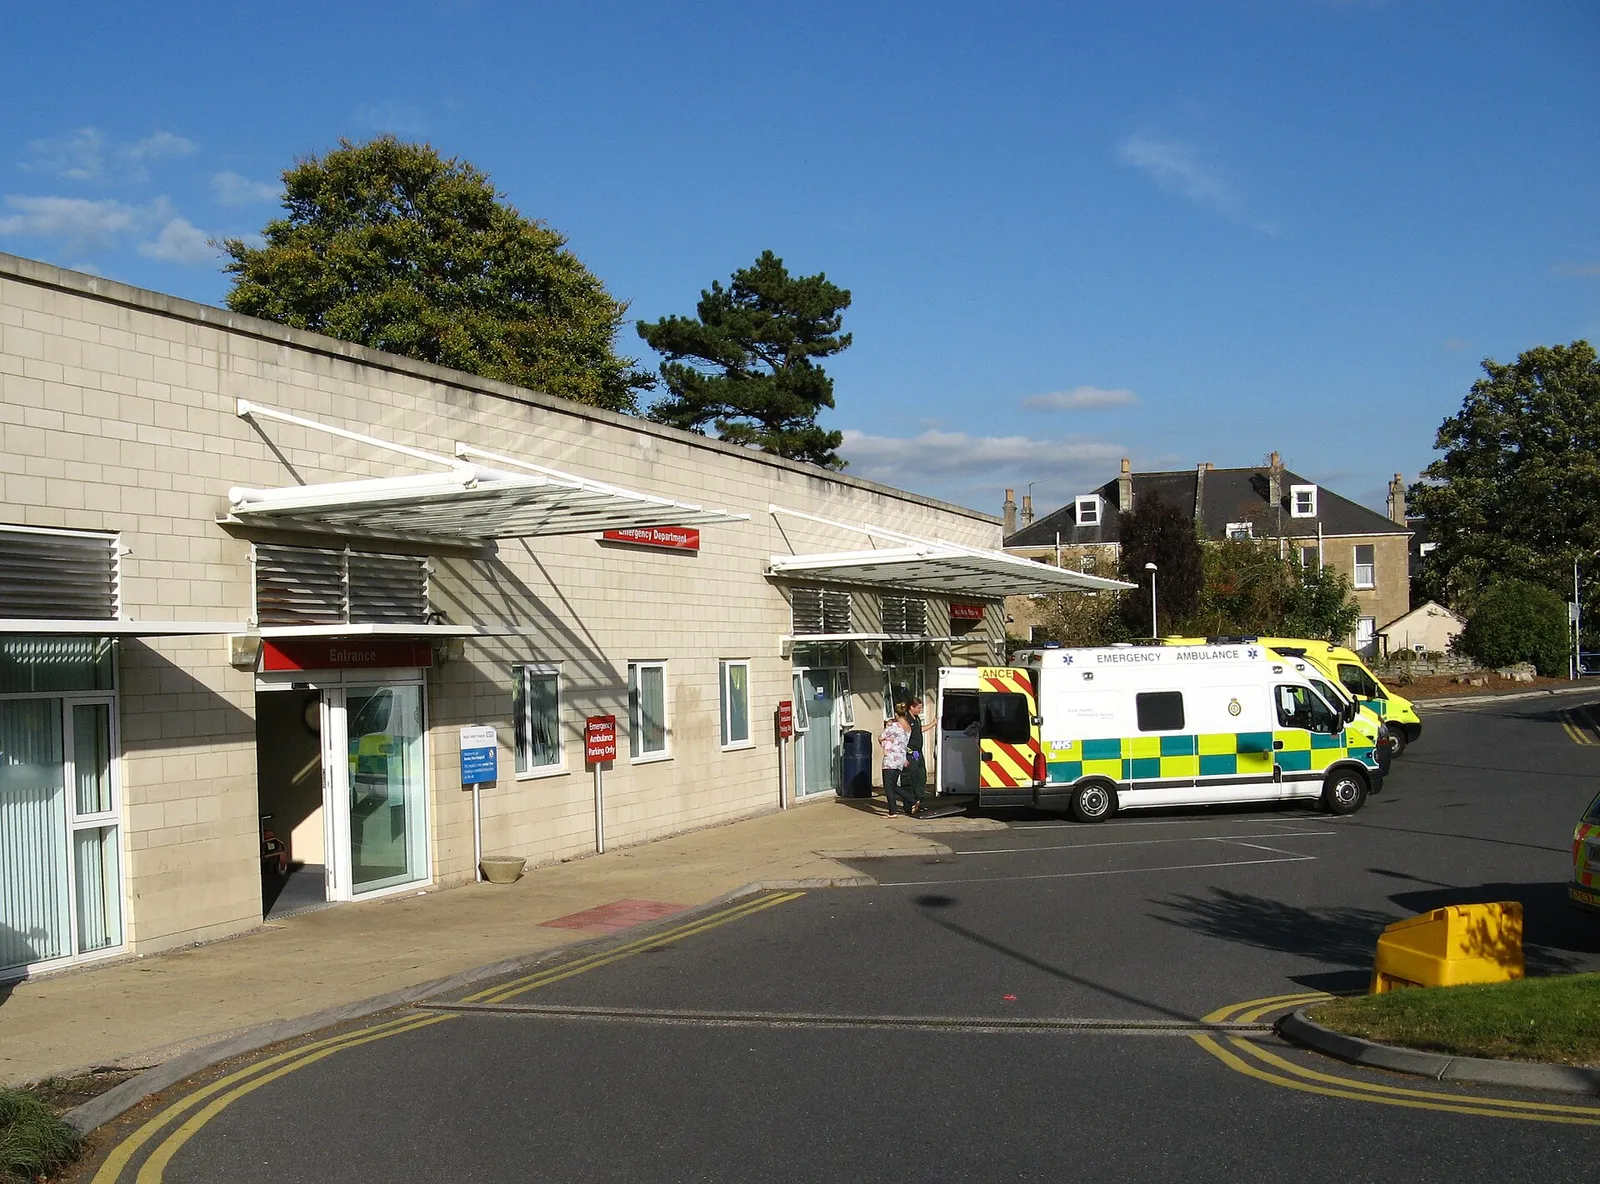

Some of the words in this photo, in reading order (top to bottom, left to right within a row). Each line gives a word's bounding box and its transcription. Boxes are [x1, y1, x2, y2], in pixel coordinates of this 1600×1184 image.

[653, 529, 687, 543] Department
[329, 649, 376, 662] Entrance
[1096, 652, 1161, 663] EMERGENCY
[1176, 650, 1239, 661] AMBULANCE
[982, 669, 1012, 678] ANCE
[589, 722, 613, 731] Emergency
[590, 734, 614, 743] Ambulance
[1051, 740, 1072, 750] NHS
[588, 747, 605, 757] Parking
[604, 745, 615, 755] Only
